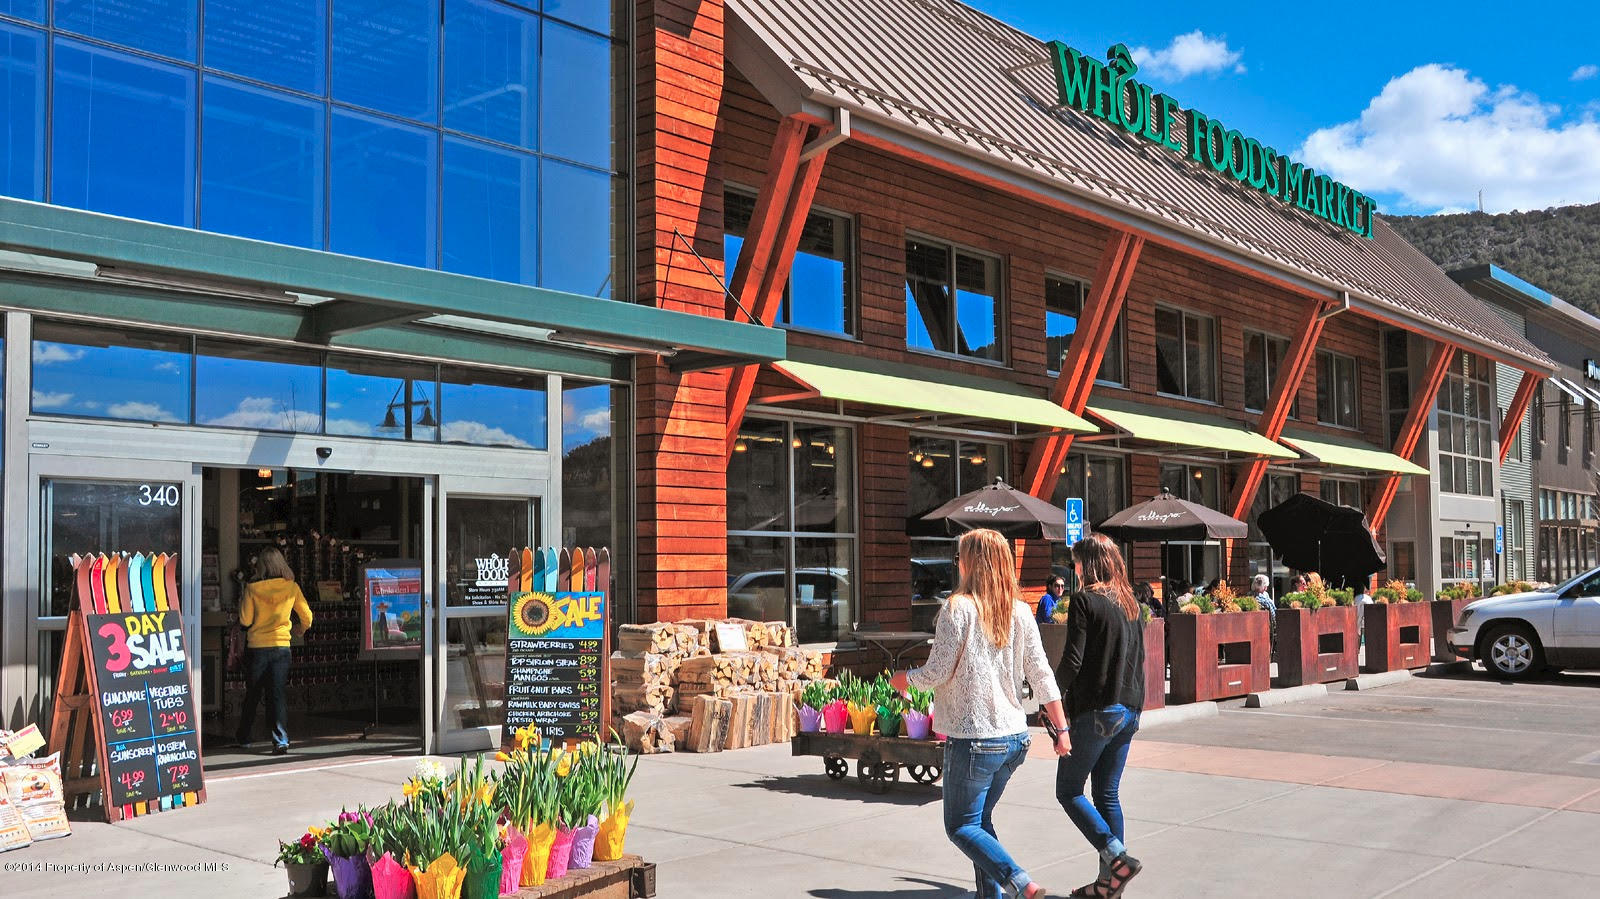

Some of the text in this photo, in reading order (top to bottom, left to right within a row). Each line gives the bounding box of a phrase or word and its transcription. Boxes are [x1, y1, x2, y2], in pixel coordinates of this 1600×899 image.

[1047, 40, 1377, 240] WHOLE FOODS MARKET
[139, 484, 179, 507] 340
[549, 596, 602, 632] SALE
[98, 612, 166, 673] 3 DAY
[126, 629, 186, 670] SALE
[510, 640, 574, 650] STRAWBERRIES
[510, 657, 525, 666] TOP
[526, 658, 554, 666] SIRLOIN
[555, 658, 578, 667] STEAK
[510, 667, 552, 675] CHAMPAGNE
[149, 684, 188, 699] VEGETABLE
[508, 685, 531, 695] FRUIT
[535, 686, 550, 694] NUT
[551, 686, 573, 694] BARS
[577, 683, 583, 692] 4
[103, 689, 147, 707] GUACAMOLE
[153, 697, 185, 710] TUBS
[538, 700, 558, 709] BABY
[558, 701, 580, 709] SWISS
[160, 713, 170, 728] 2
[546, 726, 564, 736] IRIS
[576, 724, 582, 733] 2
[110, 745, 156, 763] SUNSCREEN
[157, 740, 187, 753] 10 STEM
[157, 750, 197, 766] RANUNCULUS
